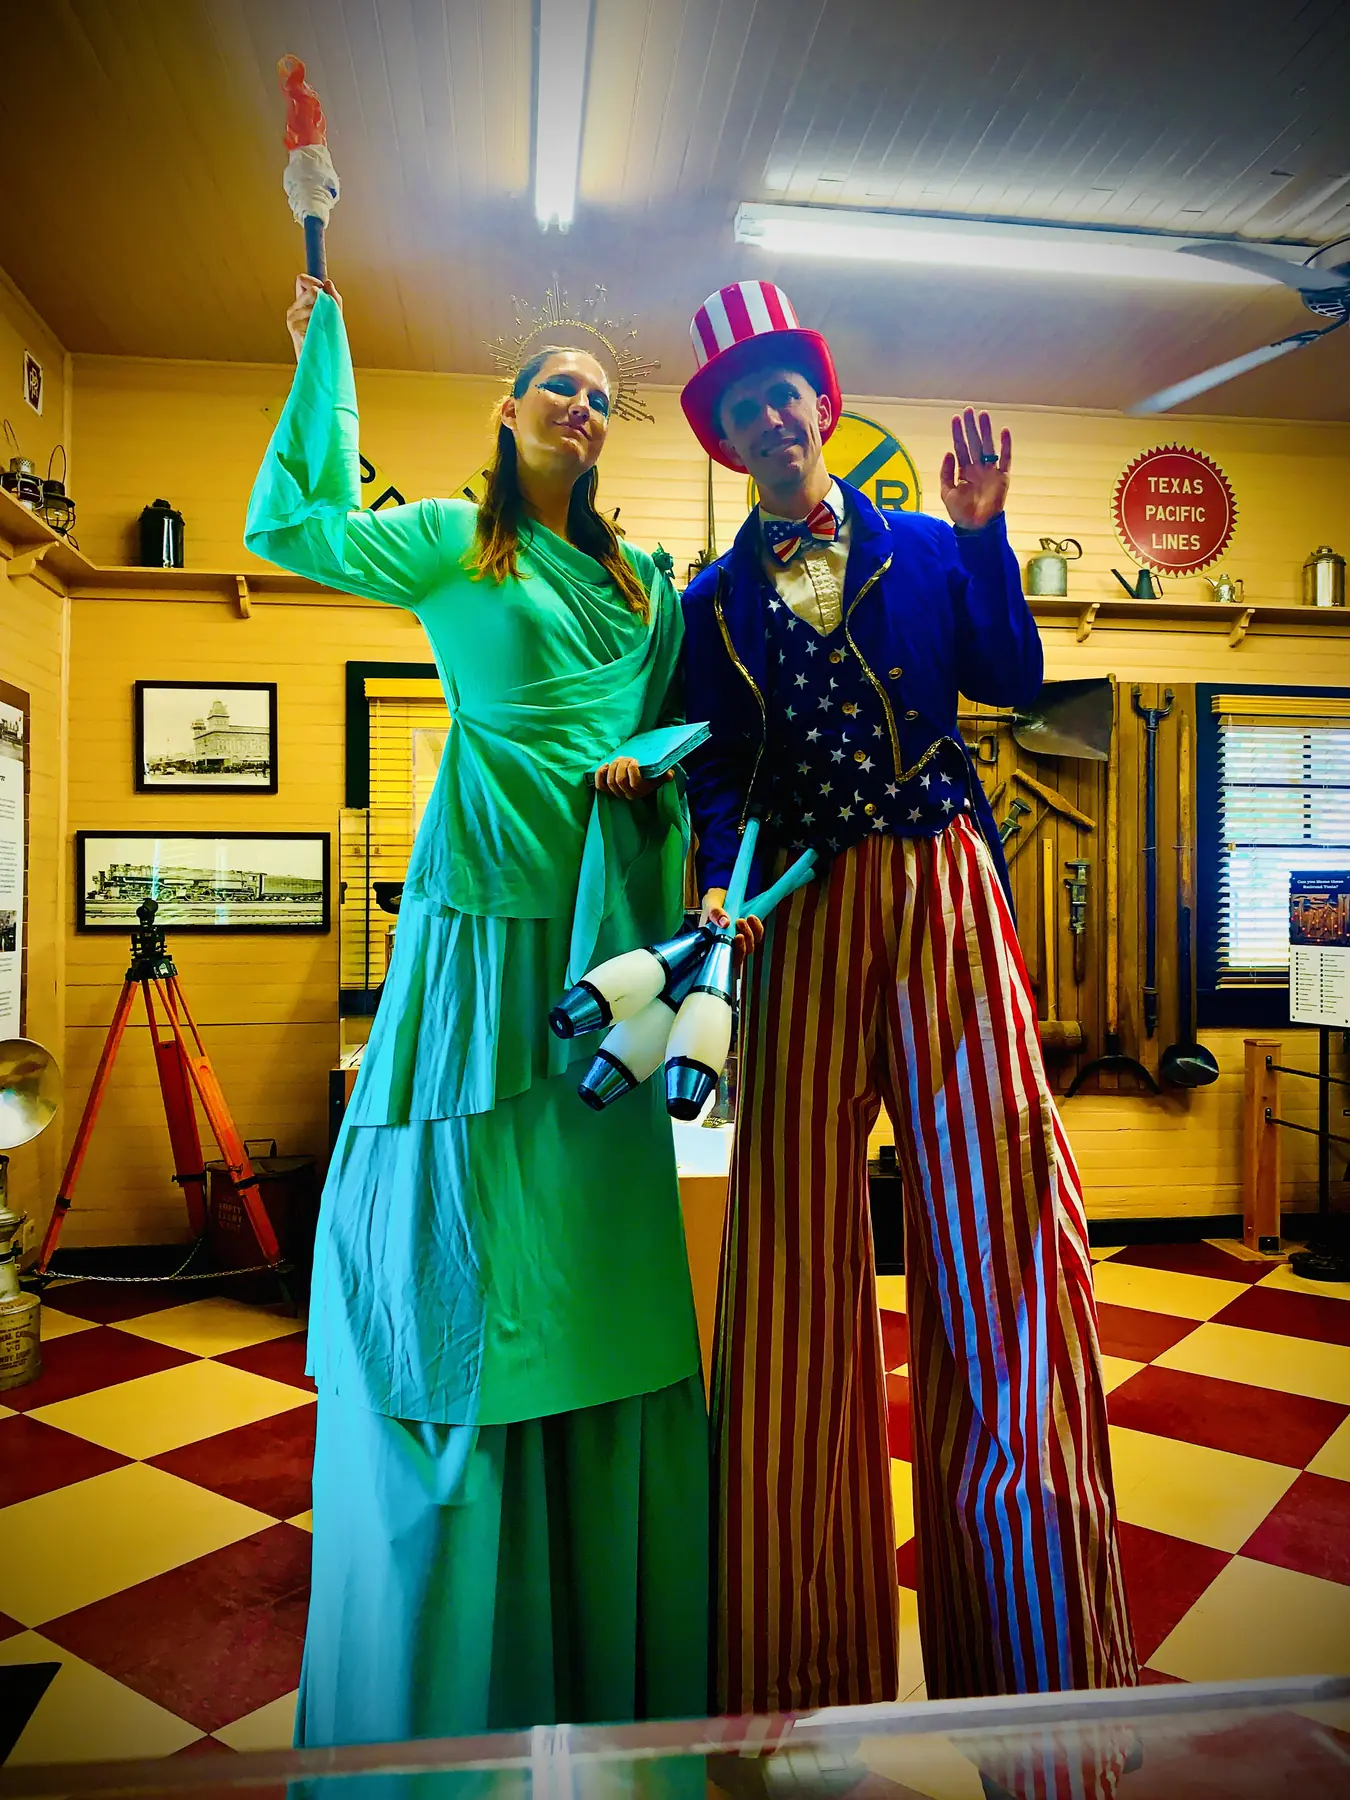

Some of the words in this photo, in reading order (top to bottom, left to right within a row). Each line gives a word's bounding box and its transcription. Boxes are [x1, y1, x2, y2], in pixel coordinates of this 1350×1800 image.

[1147, 476, 1204, 495] TEXAS
[875, 479, 909, 512] R
[1145, 504, 1206, 523] PACIFIC
[1151, 532, 1201, 551] LINES
